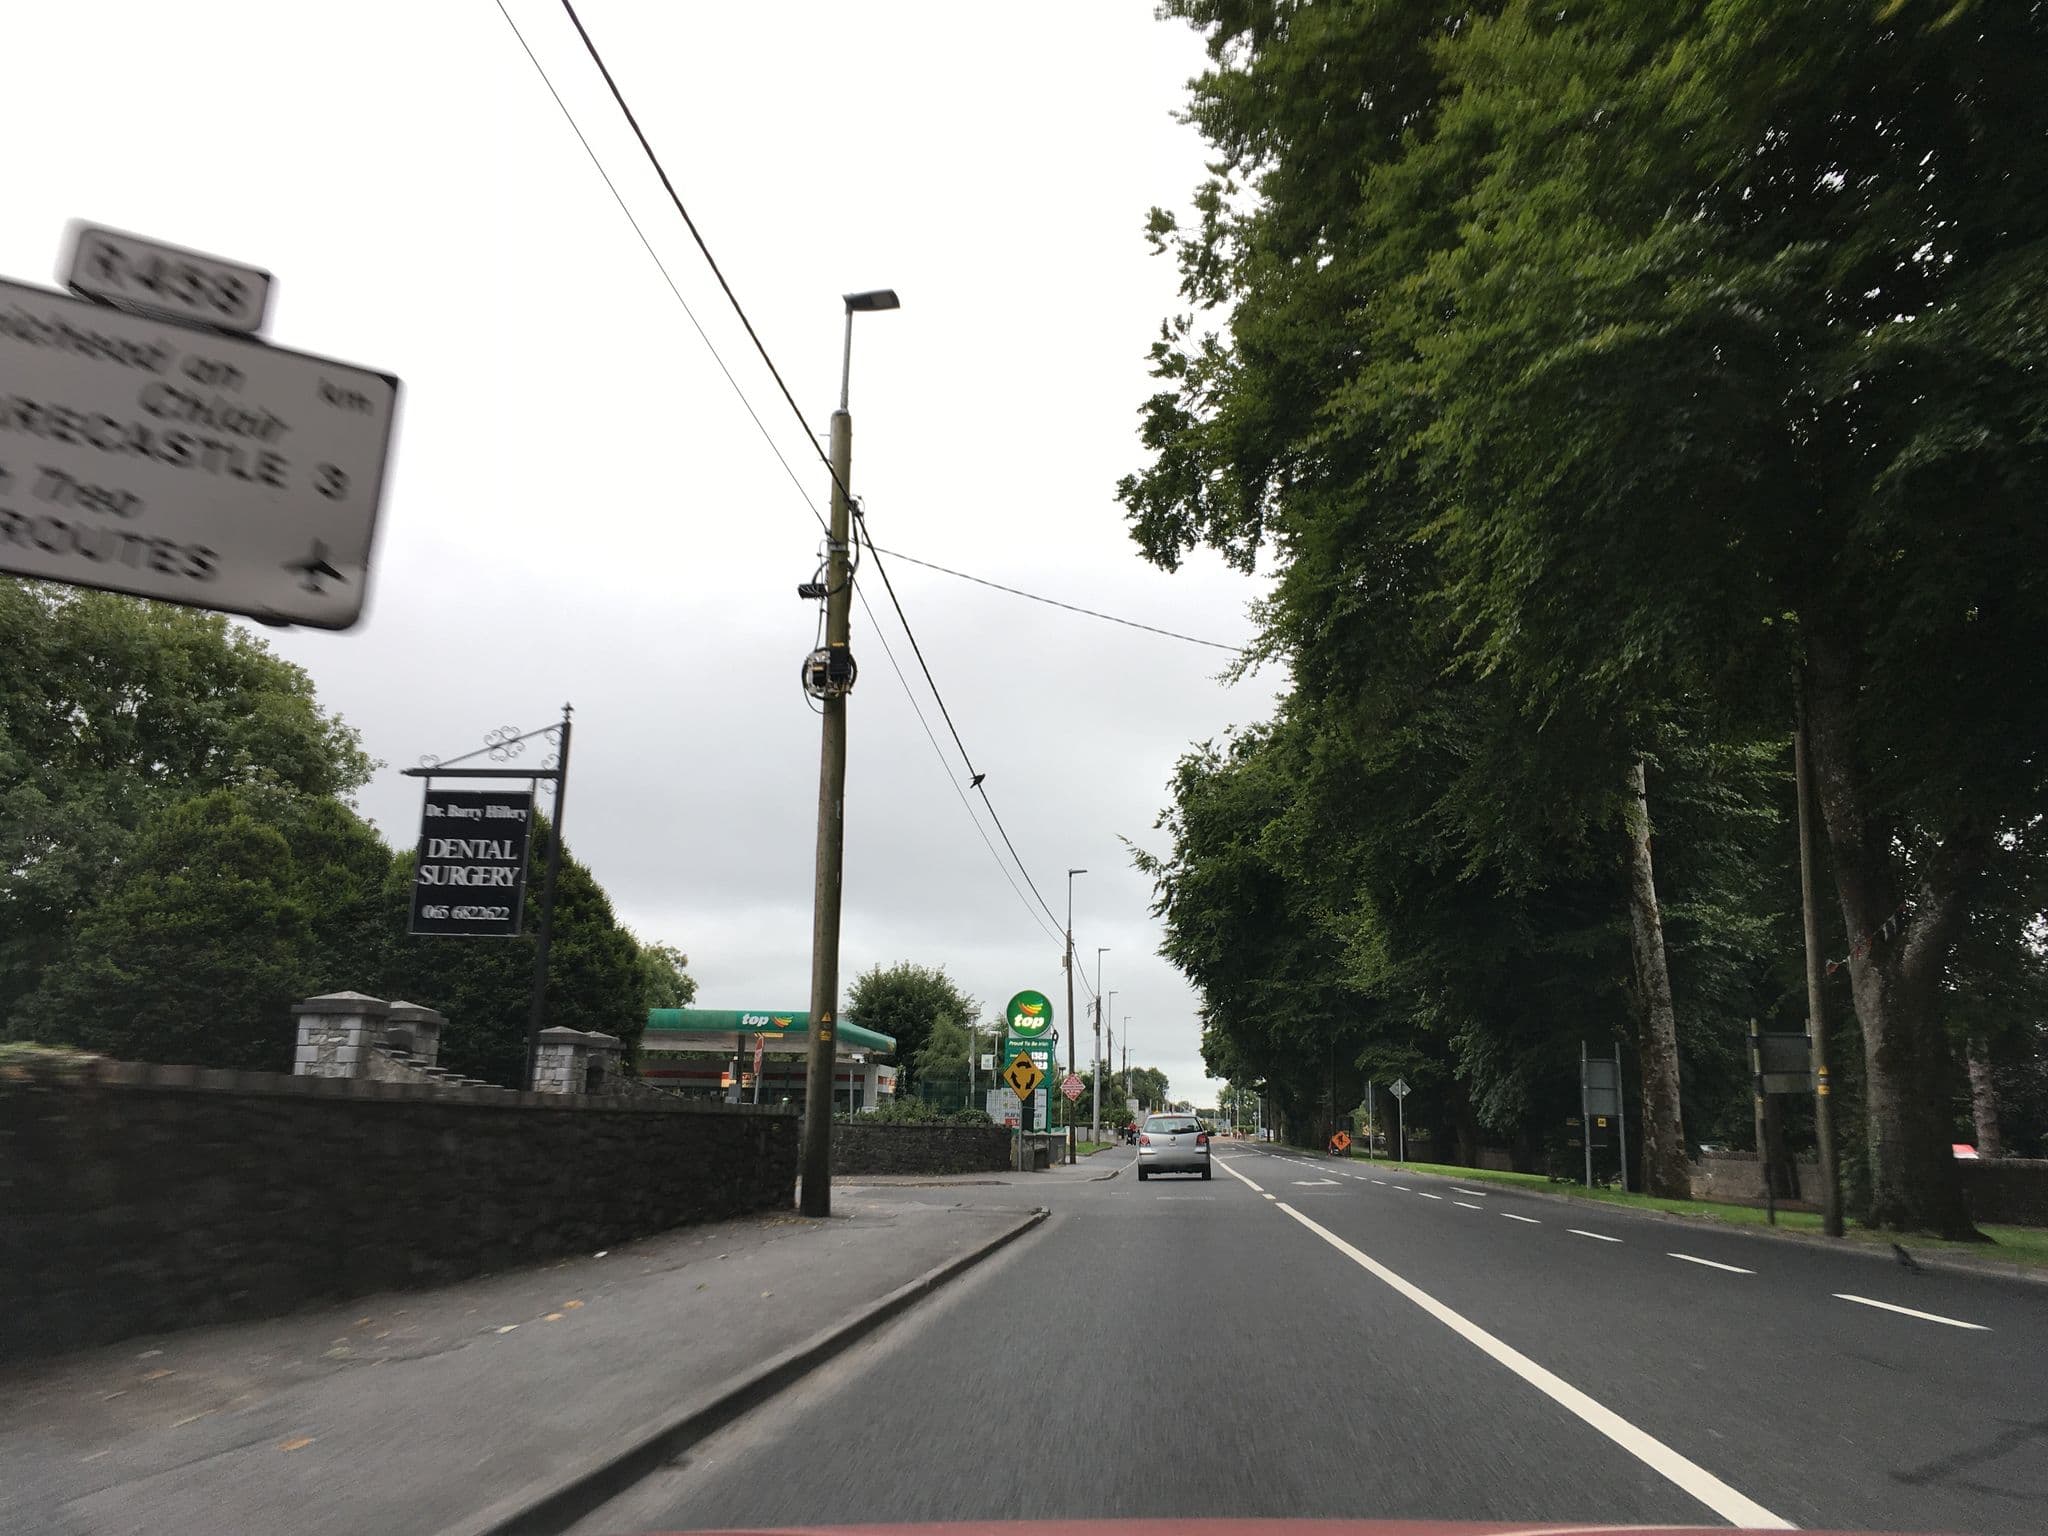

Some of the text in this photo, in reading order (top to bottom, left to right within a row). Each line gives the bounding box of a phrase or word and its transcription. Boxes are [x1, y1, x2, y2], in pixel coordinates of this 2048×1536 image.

[427, 838, 518, 860] DENTAL
[418, 864, 520, 887] SURGERY
[742, 1012, 769, 1028] top
[1014, 1014, 1044, 1028] top
